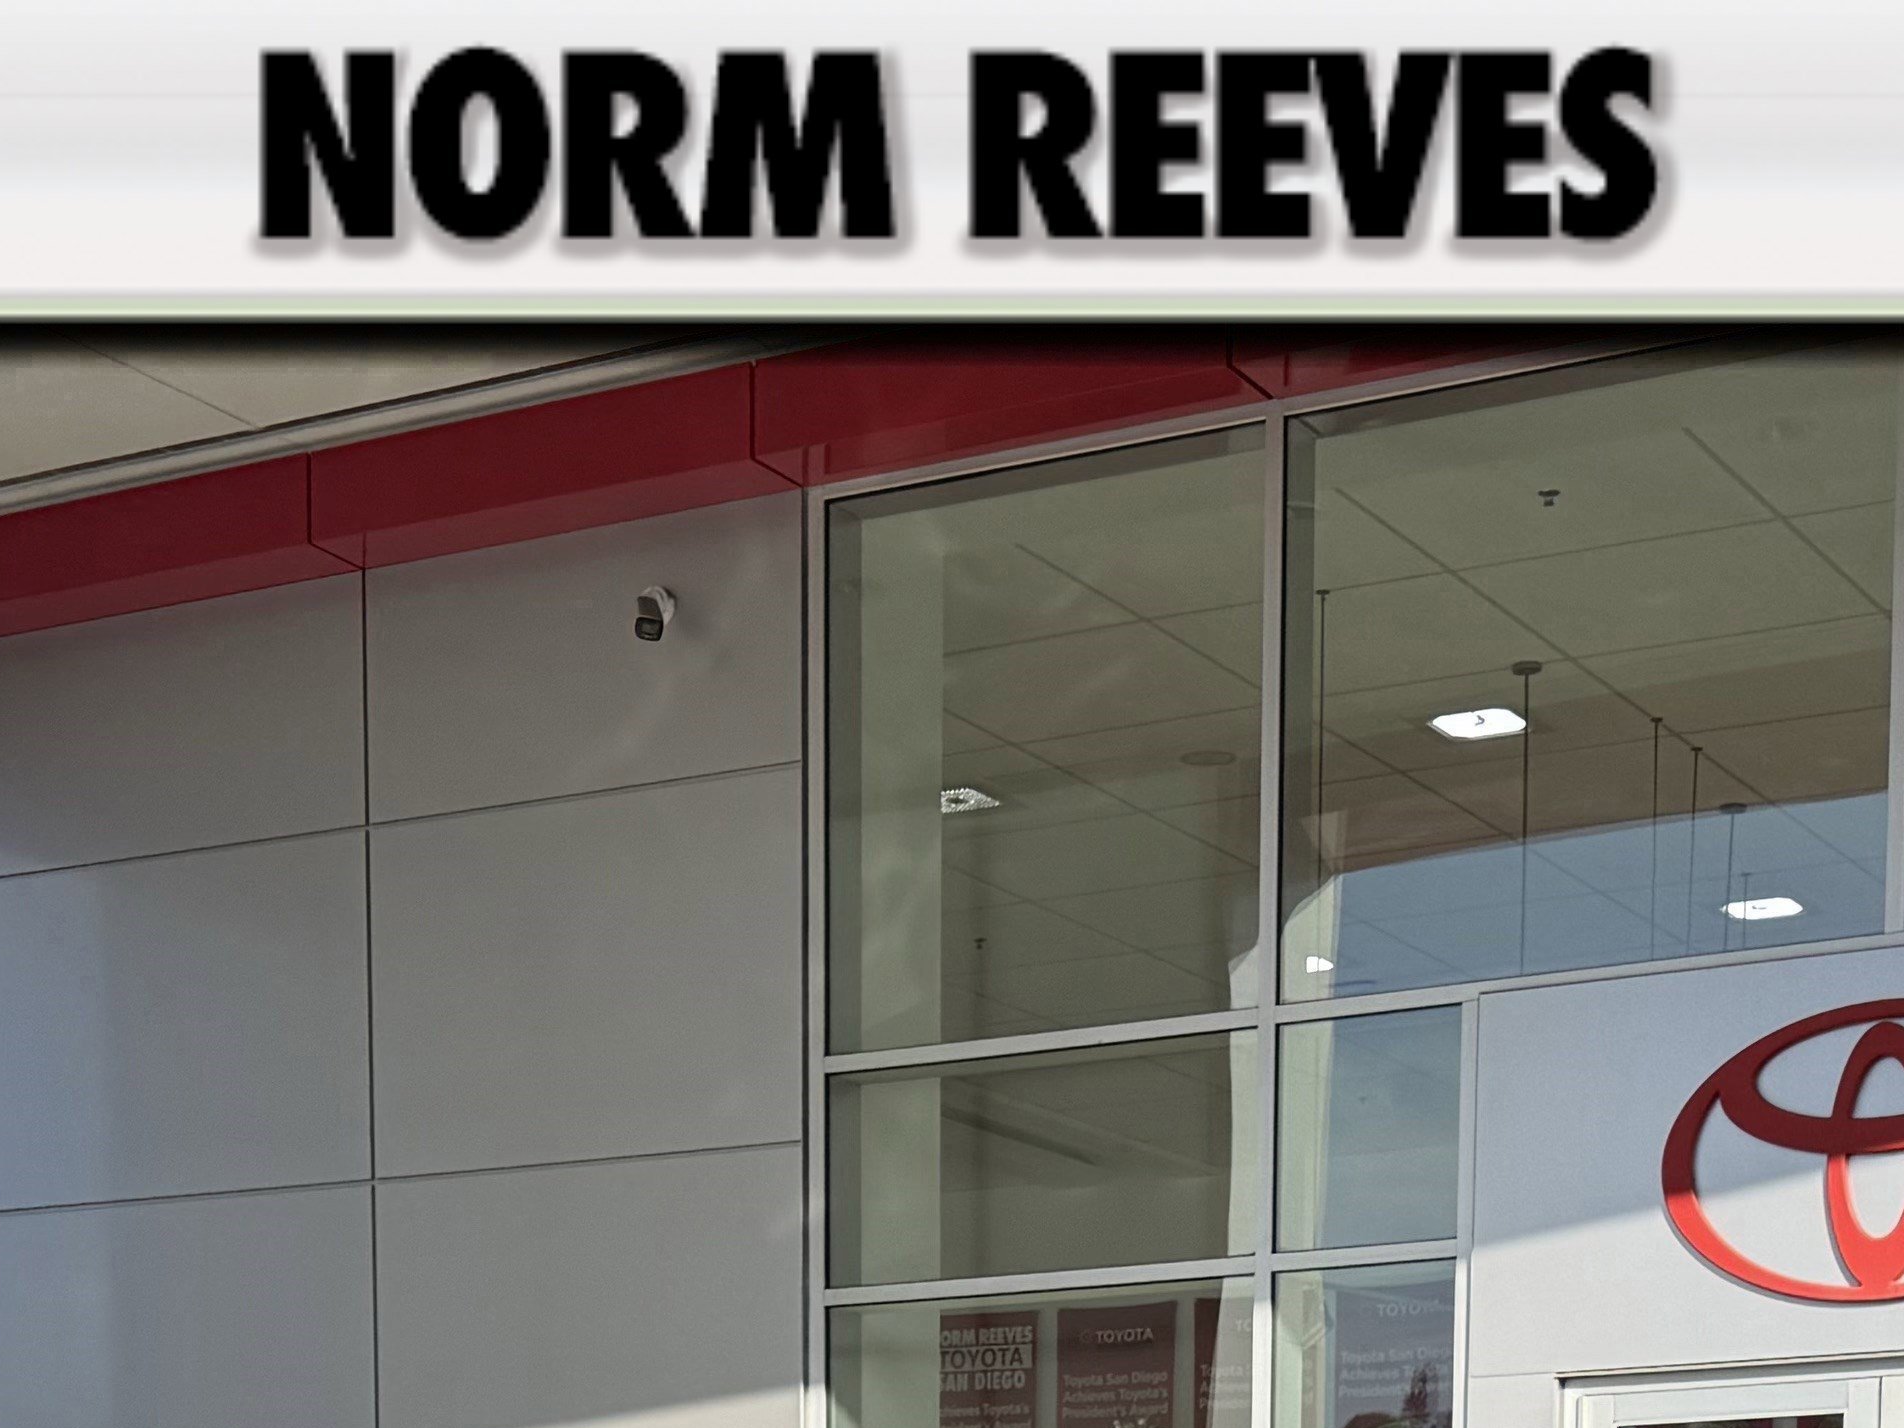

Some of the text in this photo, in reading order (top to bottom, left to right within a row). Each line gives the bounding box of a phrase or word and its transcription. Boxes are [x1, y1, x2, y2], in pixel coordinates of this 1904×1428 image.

[941, 1326, 1033, 1346] ORM REEVES
[1096, 1328, 1154, 1344] TOYOTA
[941, 1348, 1023, 1369] TOYOTA
[975, 1370, 1025, 1389] DIEGO
[1064, 1371, 1169, 1387] Toyota San Diego
